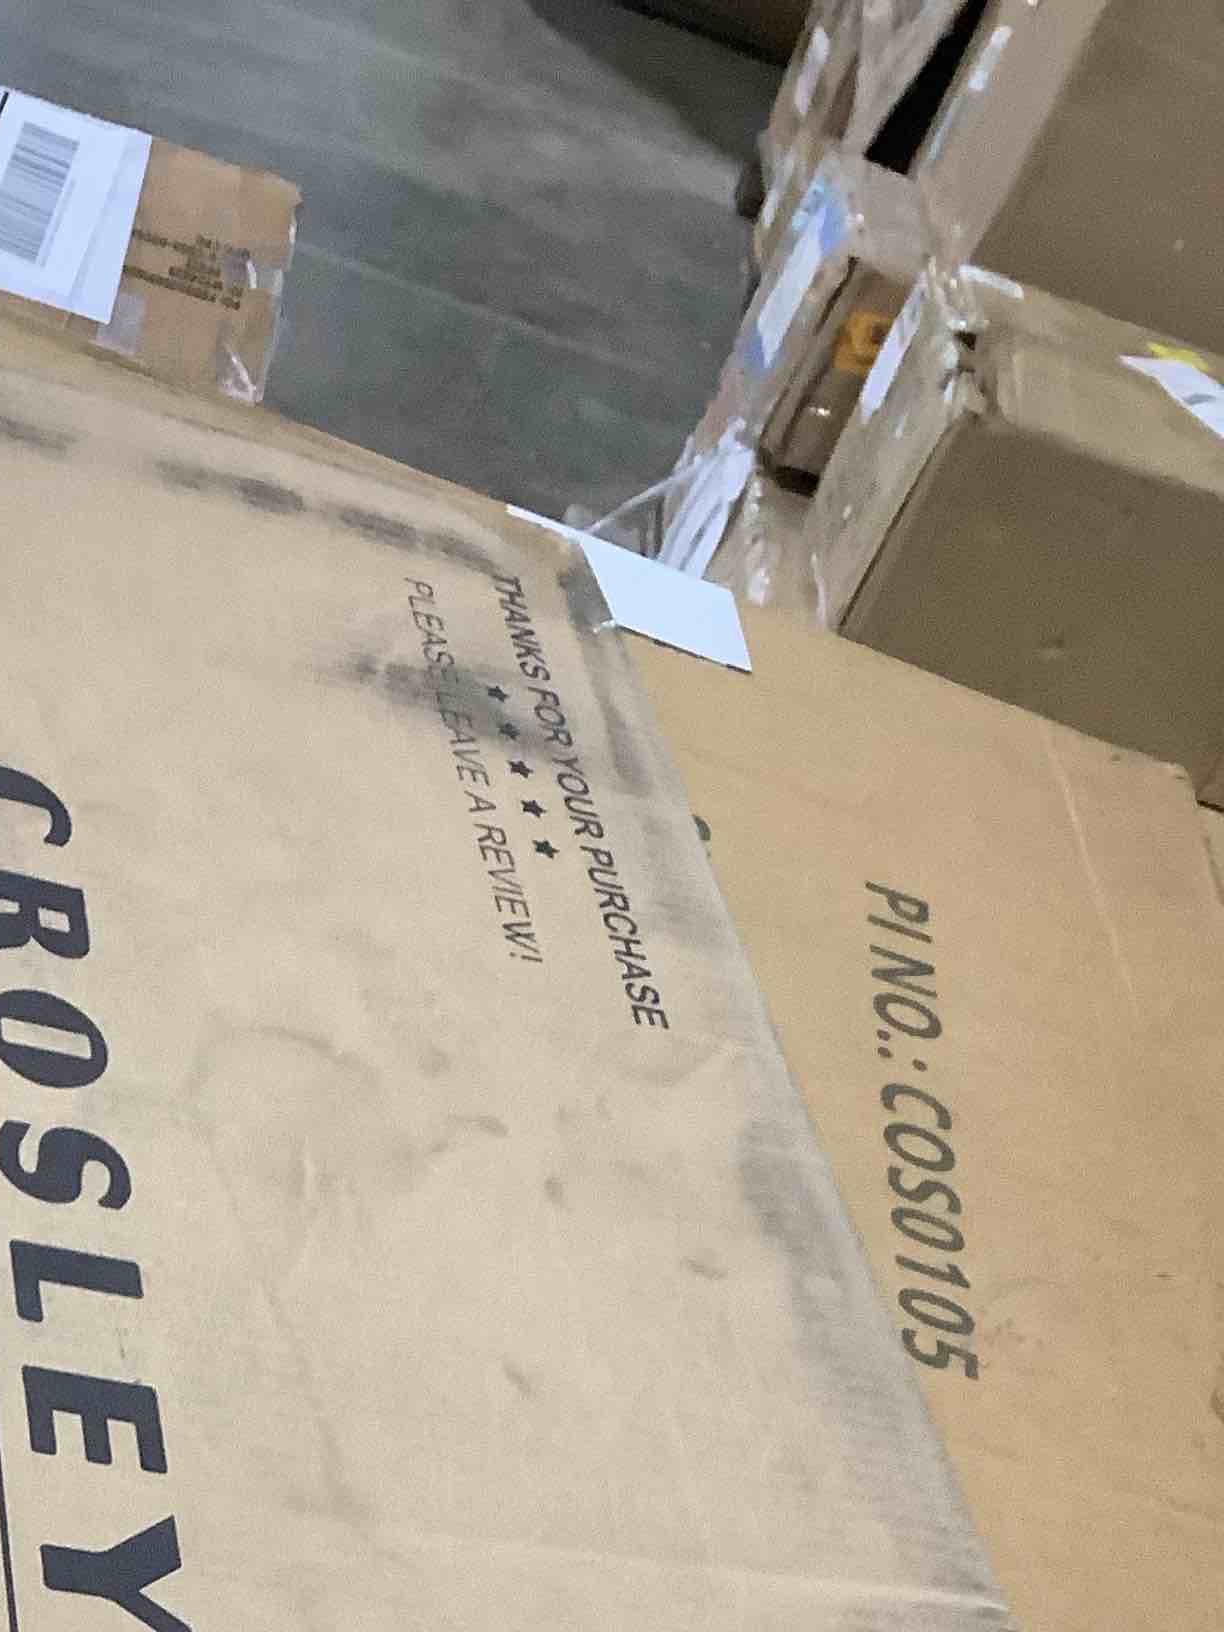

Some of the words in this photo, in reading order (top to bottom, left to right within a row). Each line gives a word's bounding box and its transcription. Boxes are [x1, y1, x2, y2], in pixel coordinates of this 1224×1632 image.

[404, 577, 460, 685] PLEASE
[436, 691, 490, 786] LEAVE
[463, 790, 497, 813] A
[493, 575, 551, 683] THANKS
[527, 686, 574, 748] FOR
[551, 757, 604, 841] YOUR
[579, 845, 669, 1030] PURCHASE
[473, 823, 544, 963] REVIEW!
